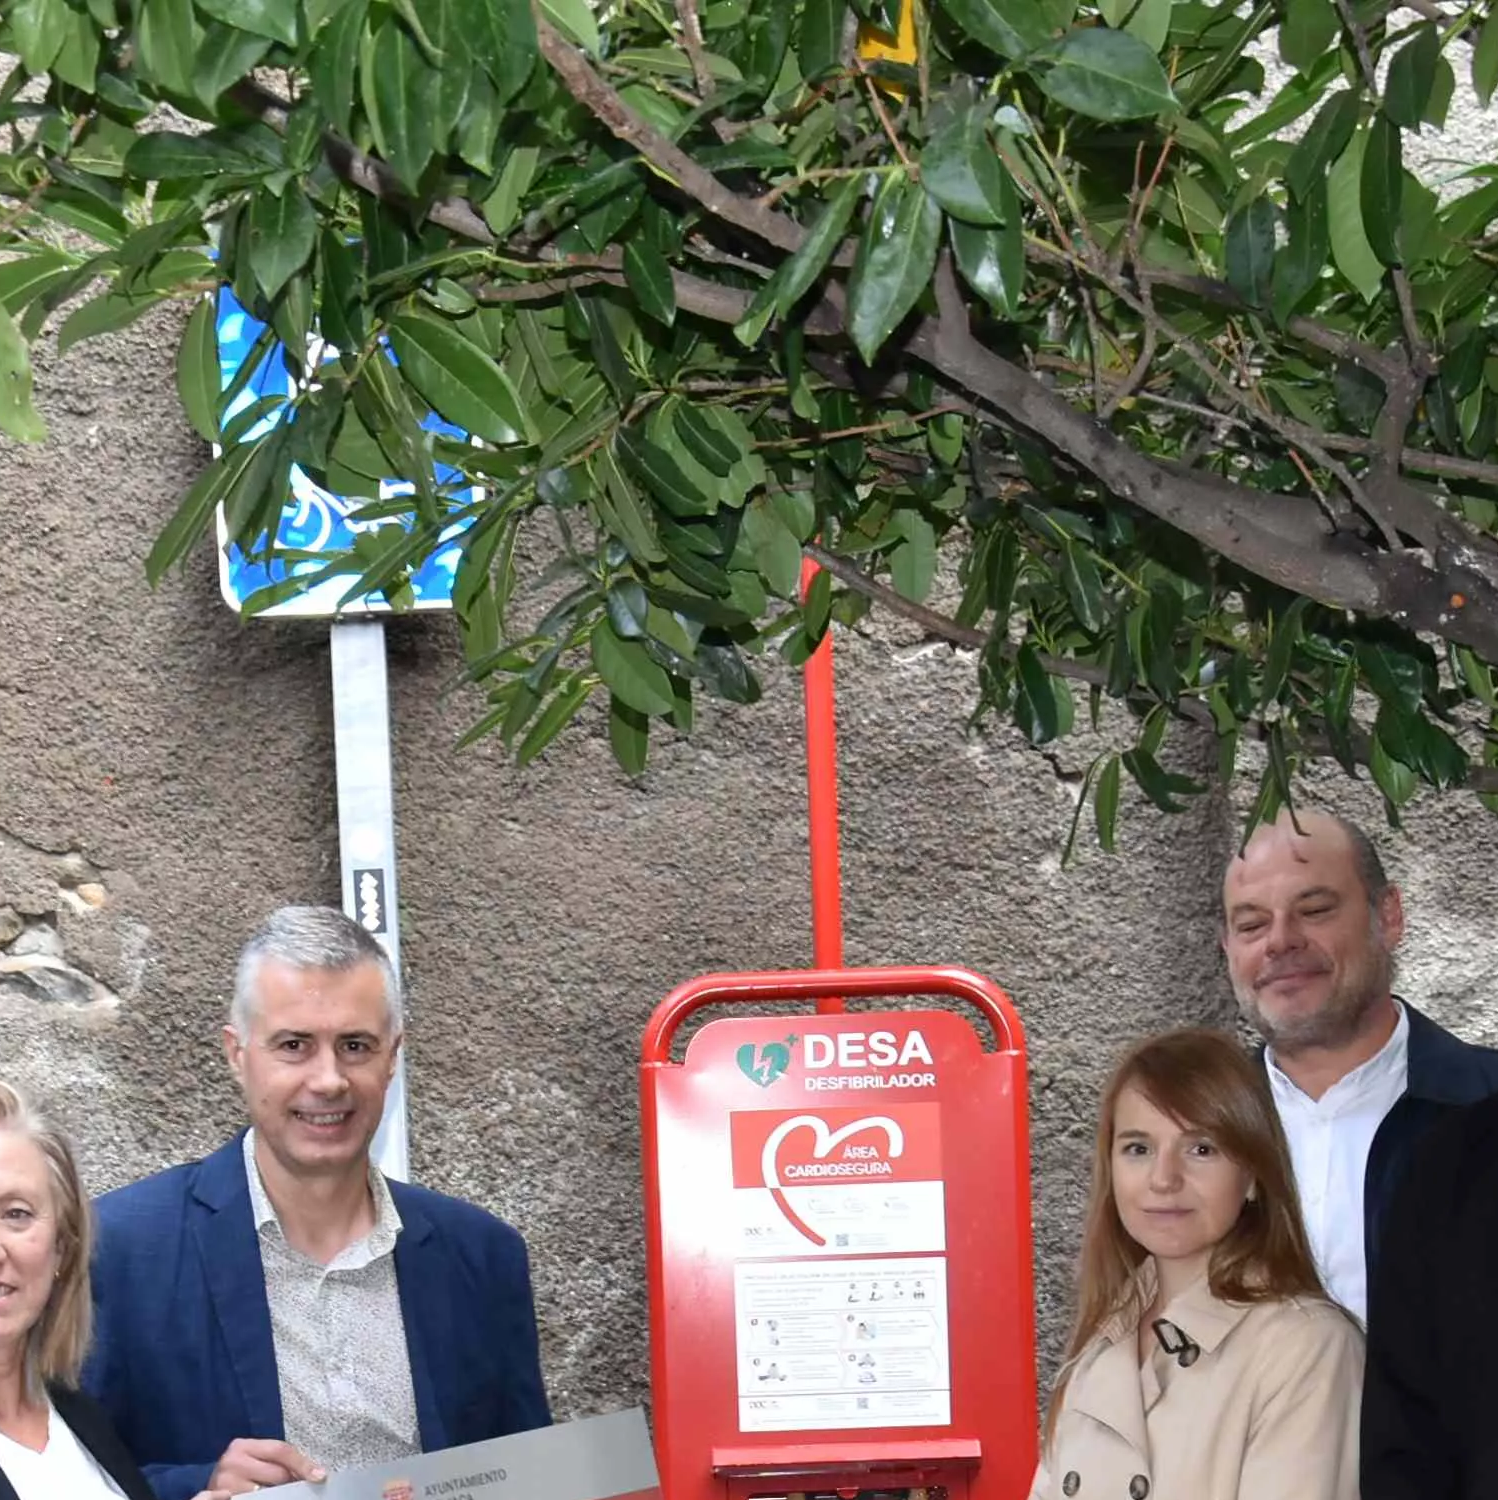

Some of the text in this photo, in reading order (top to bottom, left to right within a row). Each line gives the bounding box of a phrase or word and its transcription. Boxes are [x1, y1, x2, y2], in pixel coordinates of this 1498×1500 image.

[803, 1030, 934, 1069] DESA
[804, 1073, 936, 1091] DESFIBRILADOR
[784, 1162, 892, 1178] CARDIOSEGURA
[425, 1468, 507, 1496] AYUNTAMIENTO
